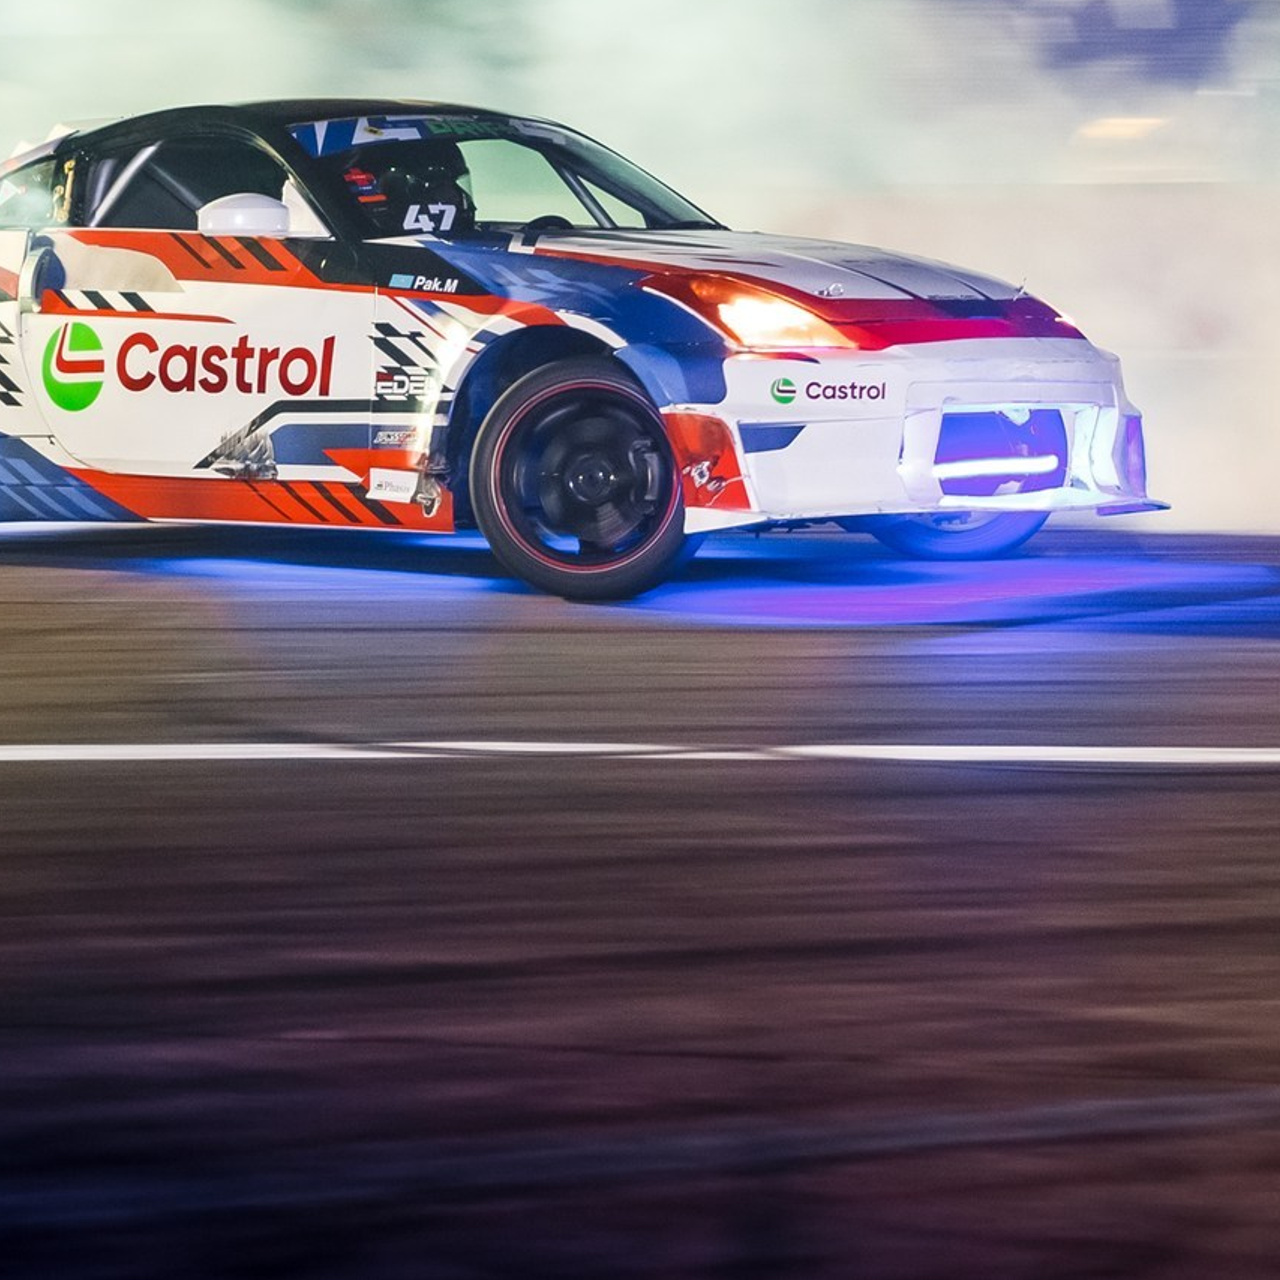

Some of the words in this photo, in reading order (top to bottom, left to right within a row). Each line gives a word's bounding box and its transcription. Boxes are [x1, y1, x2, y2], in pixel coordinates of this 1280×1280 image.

[403, 203, 457, 232] 47
[413, 275, 459, 293] Pak.M
[116, 332, 336, 397] Castrol
[805, 382, 886, 401] Castrol
